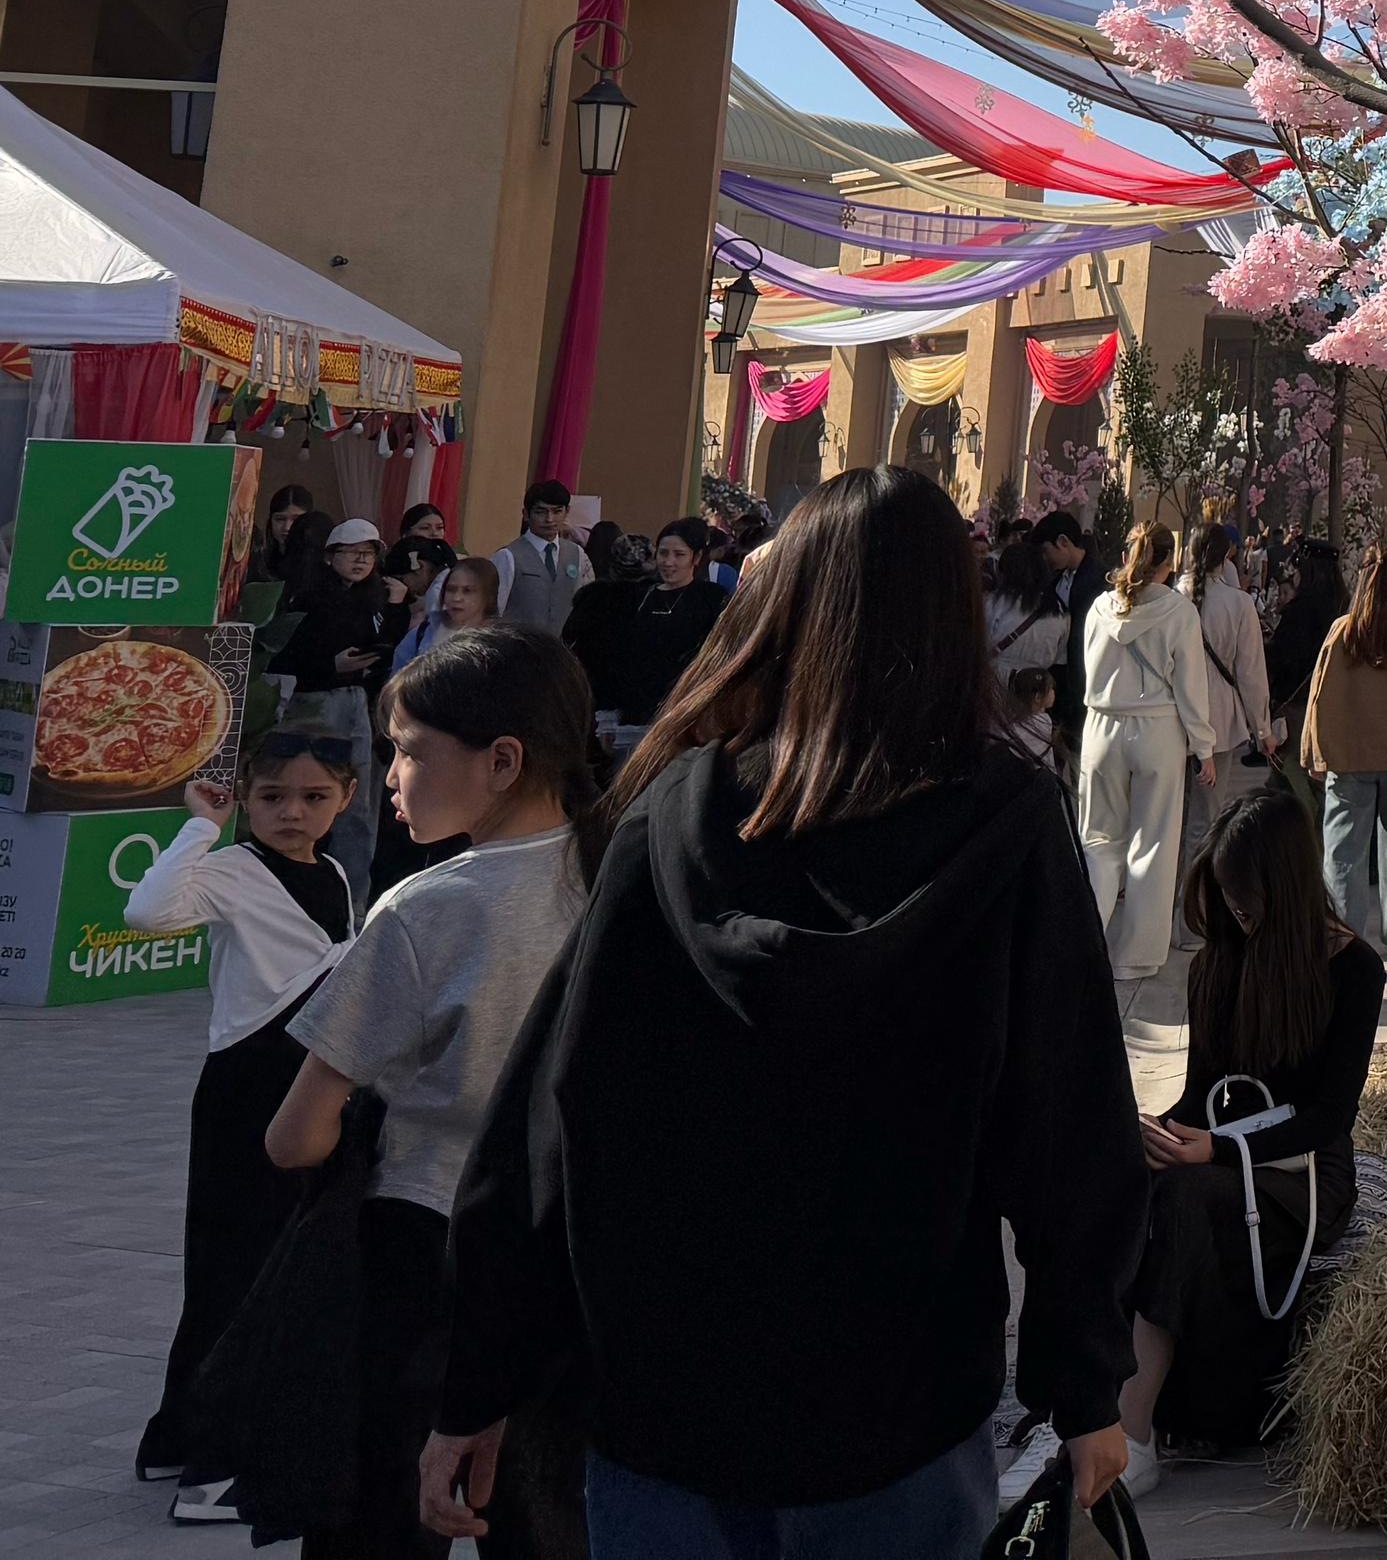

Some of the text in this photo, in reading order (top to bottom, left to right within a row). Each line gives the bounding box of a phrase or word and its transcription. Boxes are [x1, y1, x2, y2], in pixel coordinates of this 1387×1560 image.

[67, 548, 168, 572] Сочный
[46, 576, 179, 601] ДОНЕР
[69, 936, 202, 978] ЧИКЕН
